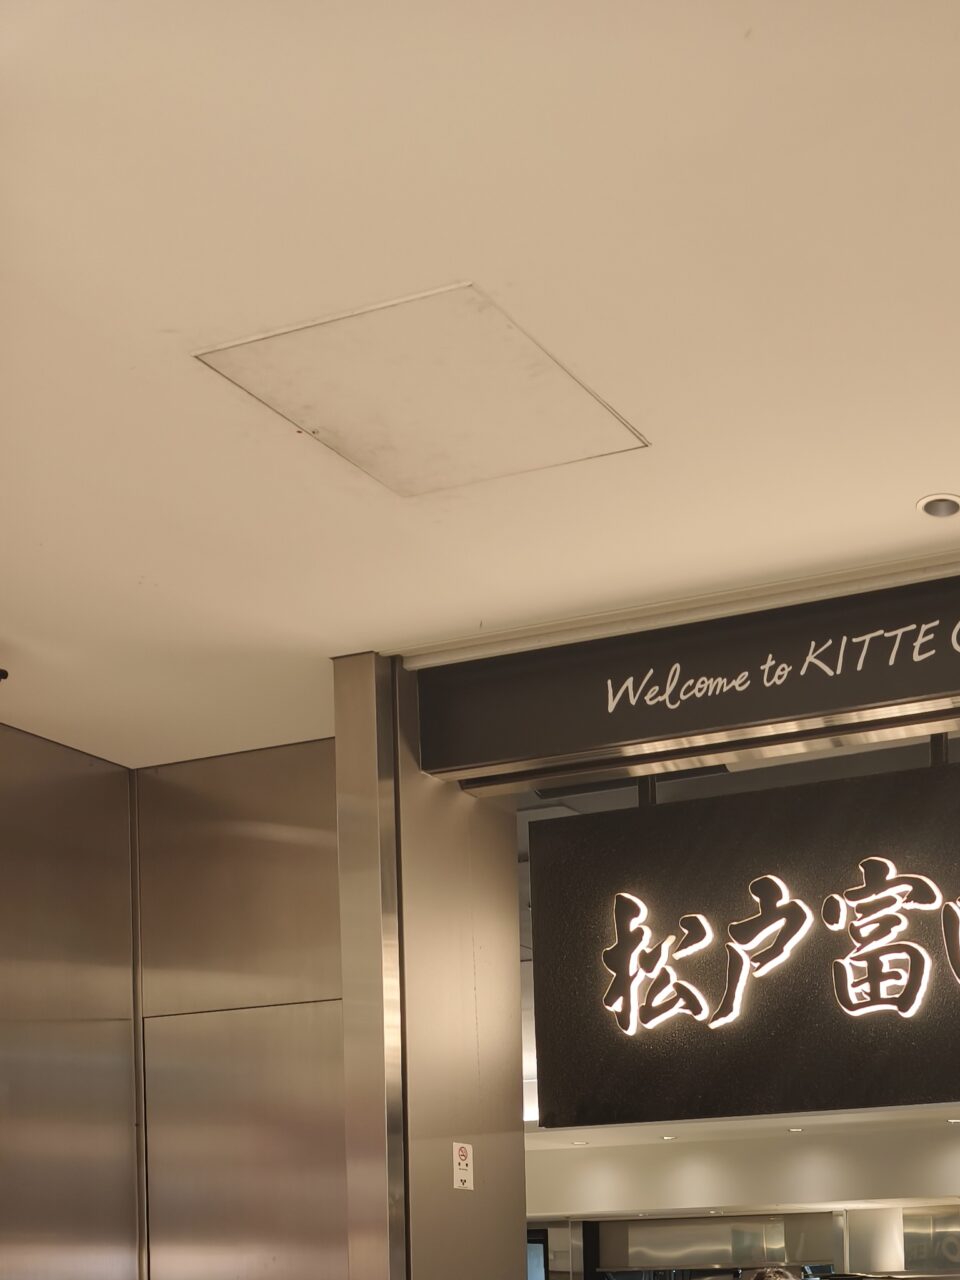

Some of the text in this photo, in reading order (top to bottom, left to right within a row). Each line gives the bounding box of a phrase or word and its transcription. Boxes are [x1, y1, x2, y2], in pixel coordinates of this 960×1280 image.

[605, 663, 751, 713] Welcome
[759, 652, 792, 688] to
[800, 619, 941, 677] KITTE
